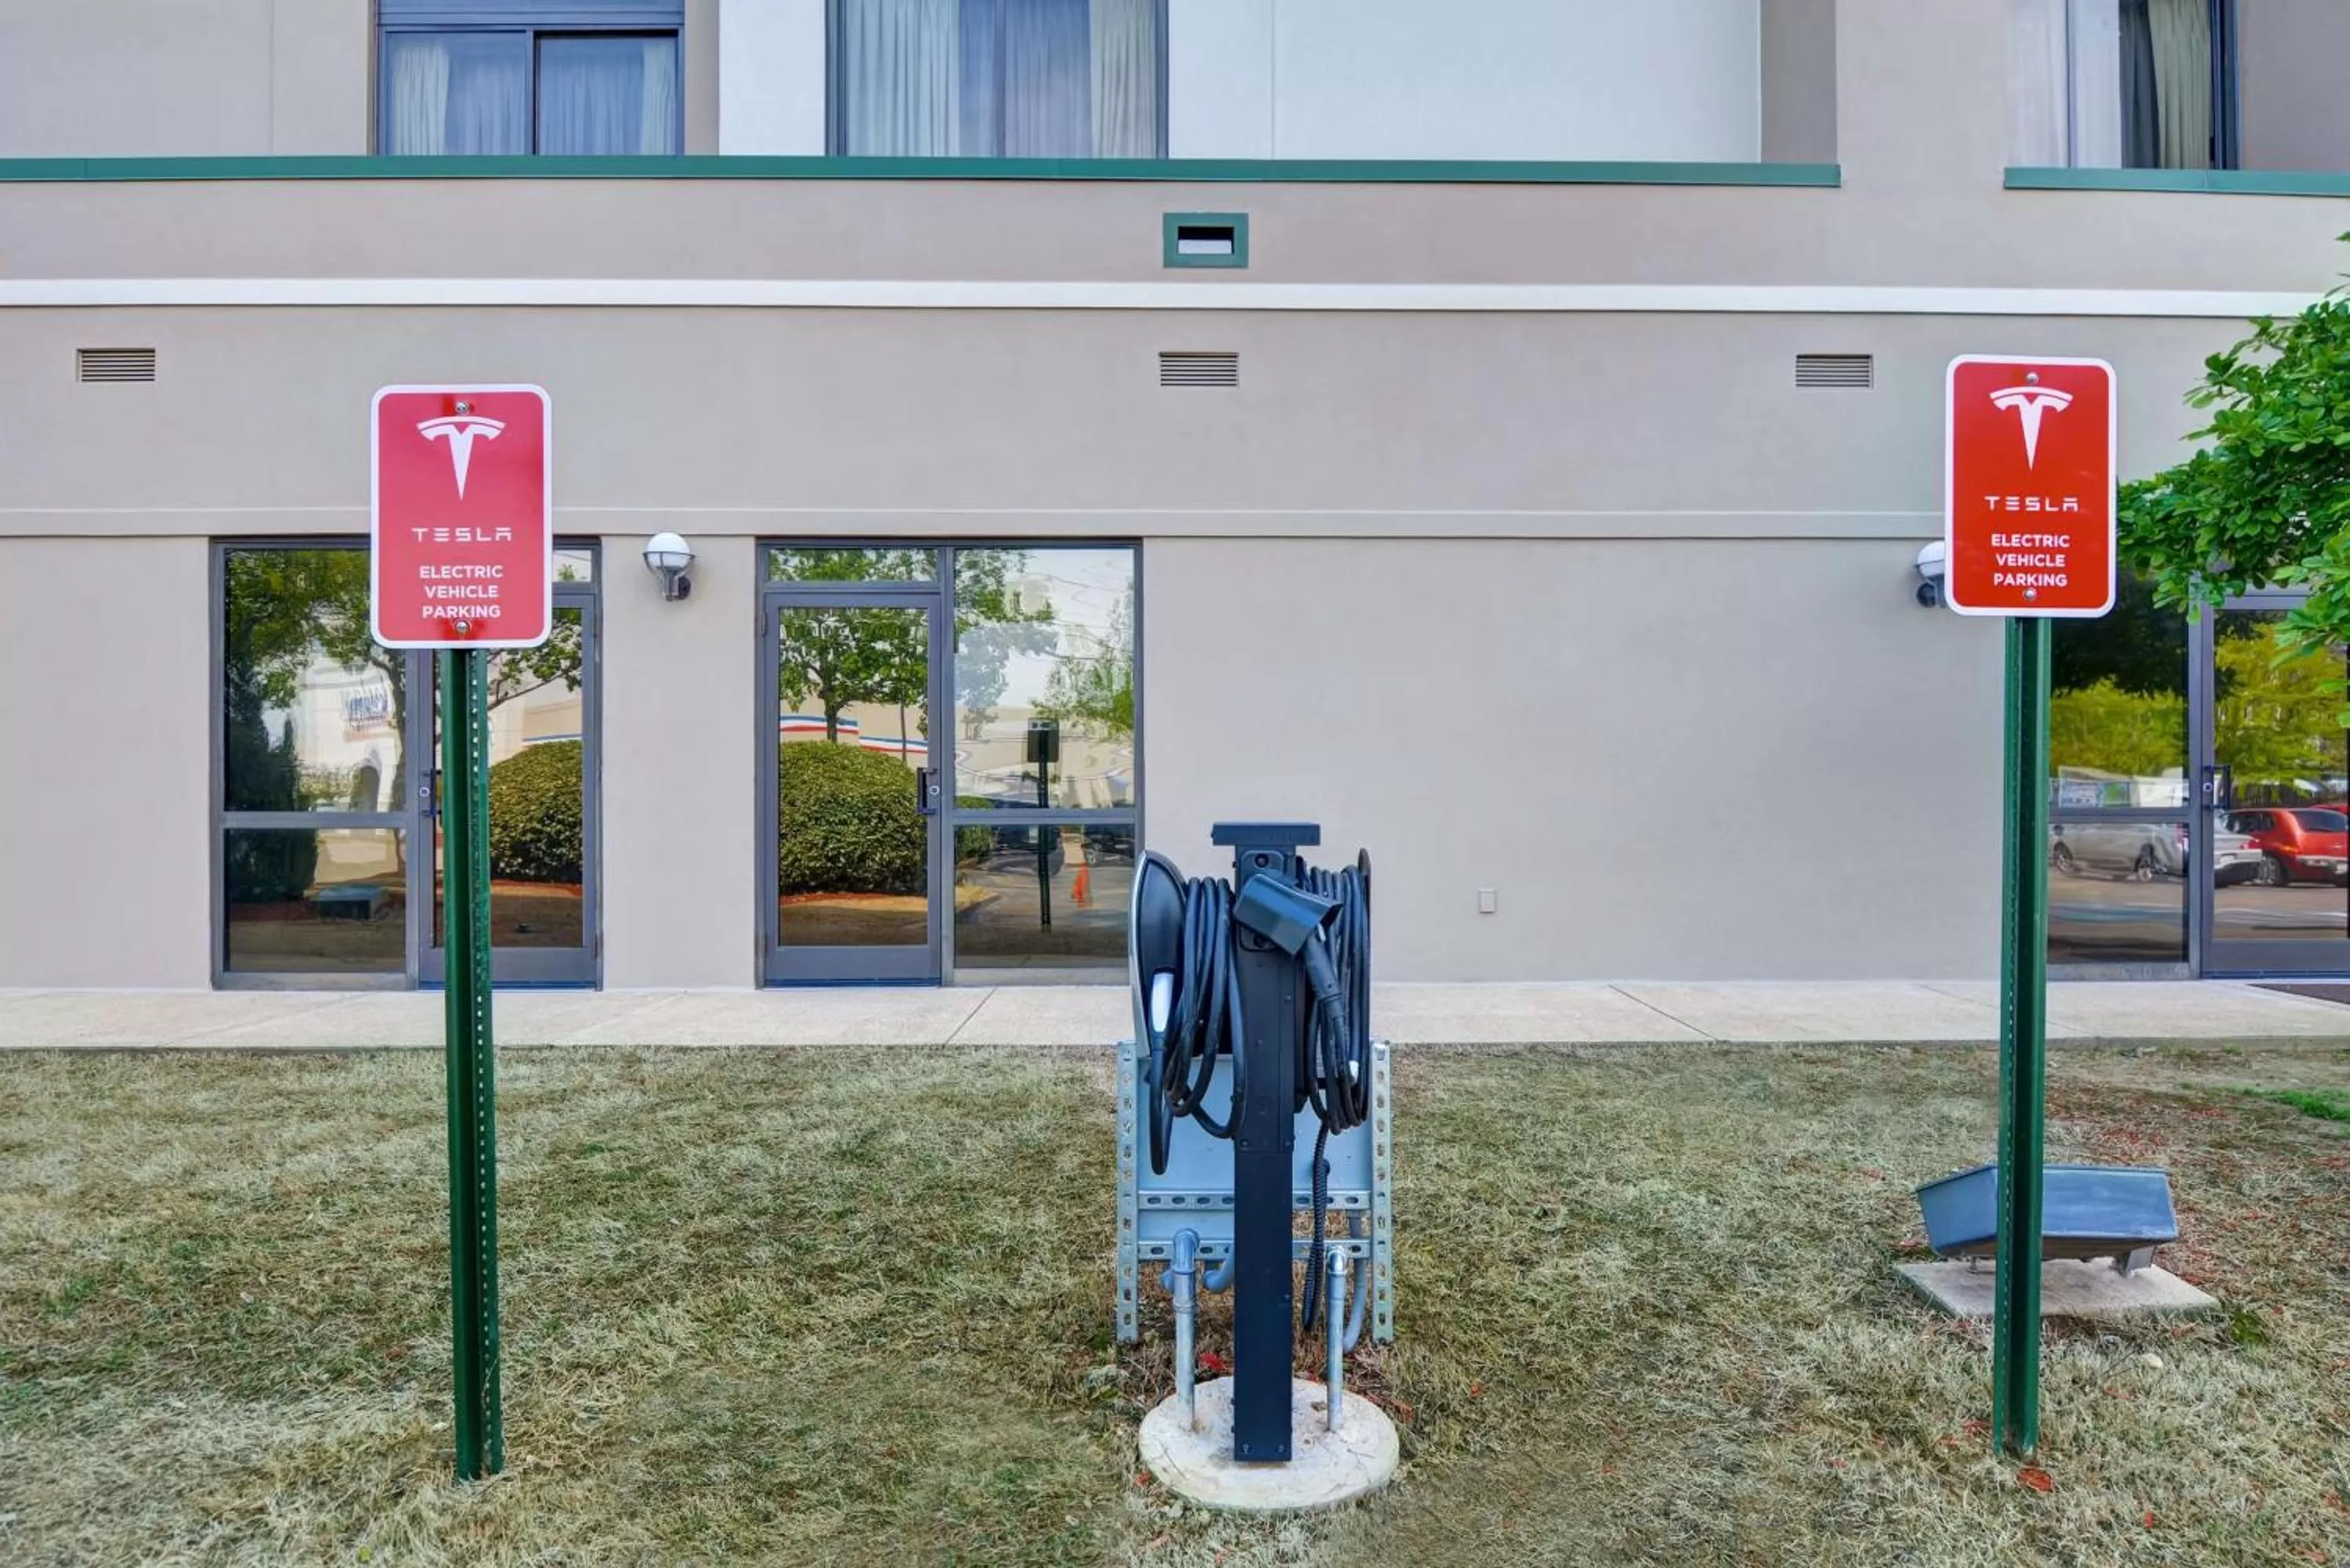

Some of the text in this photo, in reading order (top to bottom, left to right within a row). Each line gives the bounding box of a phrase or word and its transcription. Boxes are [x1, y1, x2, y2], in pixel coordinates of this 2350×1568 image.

[1983, 496, 2078, 511] TESLA
[411, 527, 512, 542] TESLA
[1991, 533, 2070, 547] ELECTRIC
[1995, 554, 2066, 567] VEHICLE
[419, 565, 504, 579] ELECTRIC
[1994, 573, 2068, 587] PARKING
[425, 585, 499, 598] VEHICLE
[422, 605, 501, 619] PARKING
